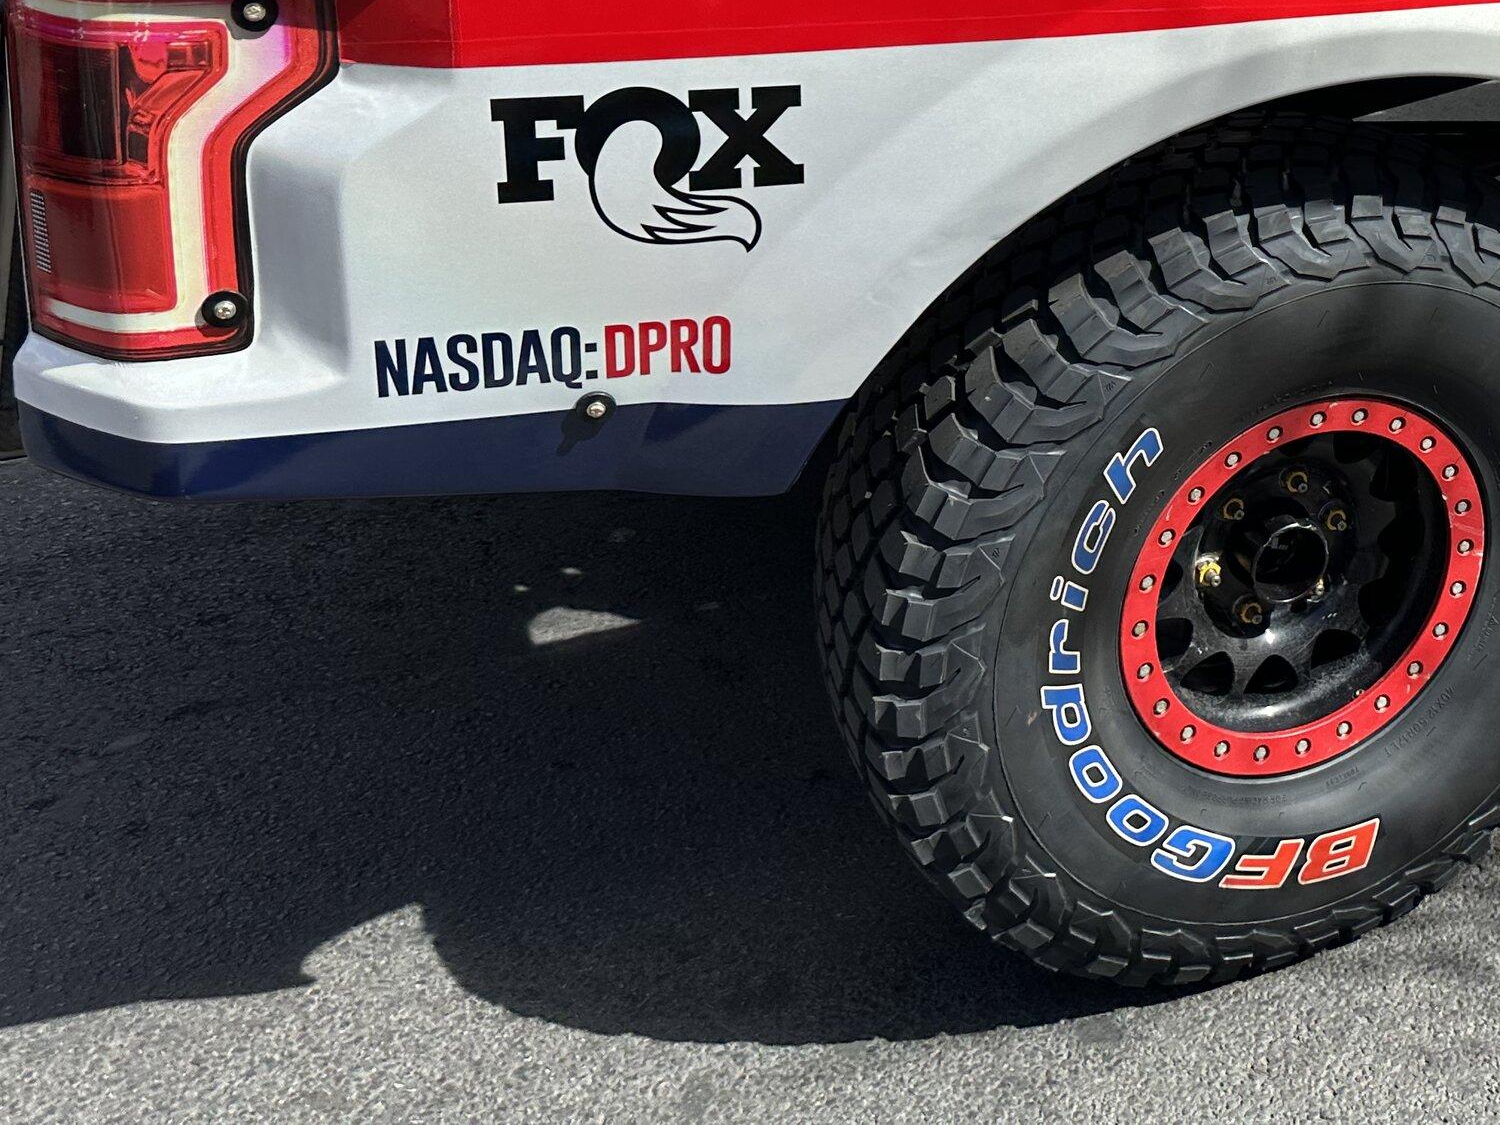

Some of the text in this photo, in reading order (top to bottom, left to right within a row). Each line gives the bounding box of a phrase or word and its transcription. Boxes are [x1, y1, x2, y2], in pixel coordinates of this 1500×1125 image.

[490, 84, 805, 252] FOX
[374, 315, 731, 397] NASDAQ:DPRO
[1040, 426, 1381, 890] BFGoodrich
